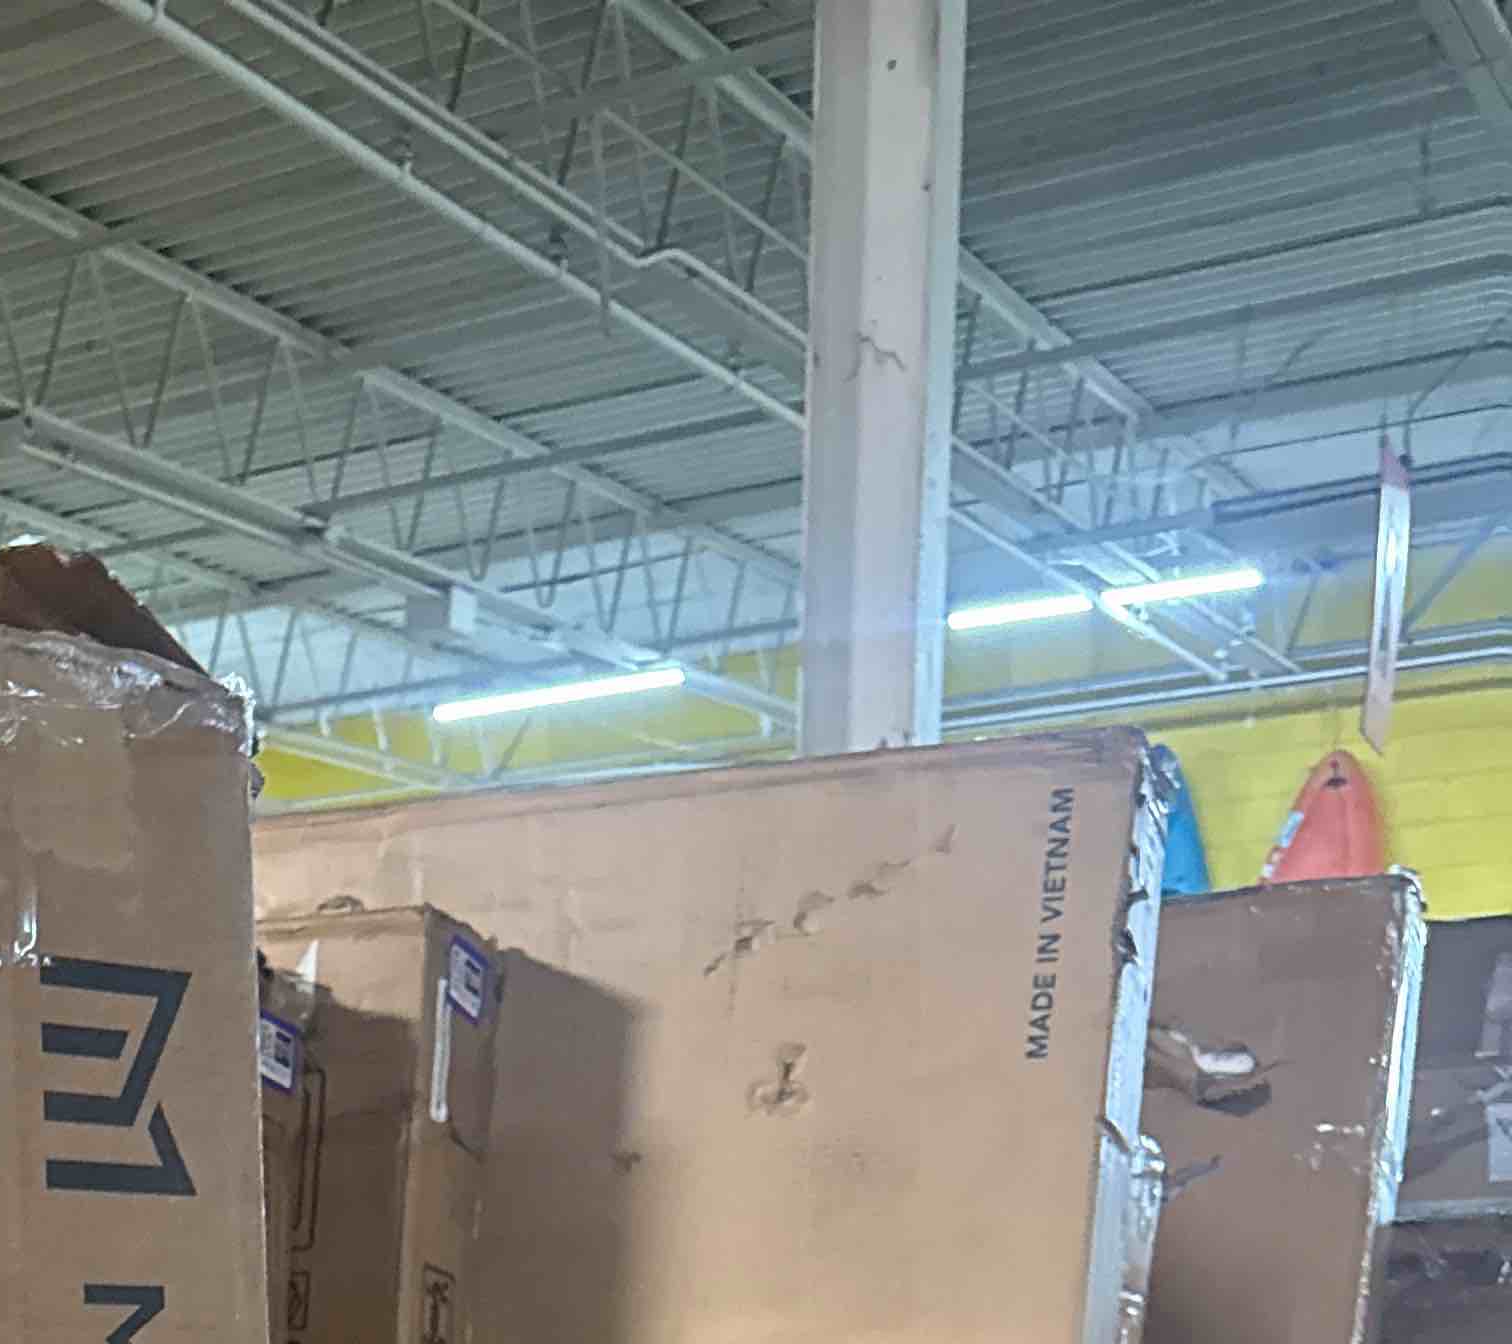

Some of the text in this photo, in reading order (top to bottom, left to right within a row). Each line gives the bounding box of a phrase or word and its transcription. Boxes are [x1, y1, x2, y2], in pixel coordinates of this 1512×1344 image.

[1025, 786, 1075, 1060] MADE IN VIETNAM
